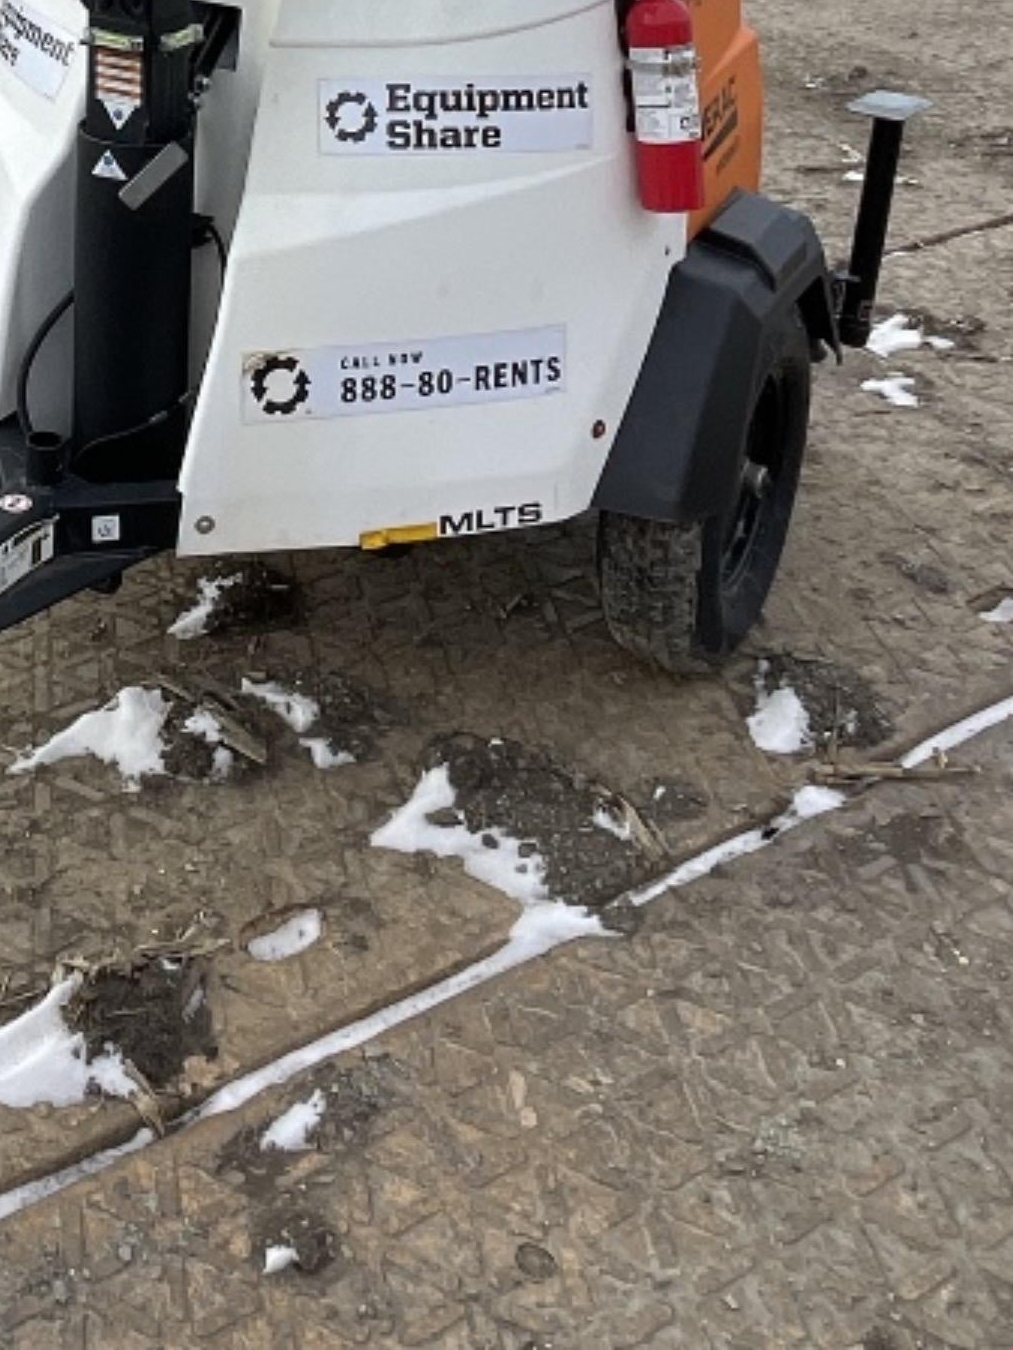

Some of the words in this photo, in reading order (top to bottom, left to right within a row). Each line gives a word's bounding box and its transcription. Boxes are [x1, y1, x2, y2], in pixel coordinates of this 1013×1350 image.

[385, 82, 588, 120] Equipment
[385, 119, 502, 150] Share
[340, 356, 380, 370] CALL
[388, 351, 423, 366] NOW
[340, 356, 562, 403] 888-80-RENTS
[439, 503, 543, 535] MLTS
